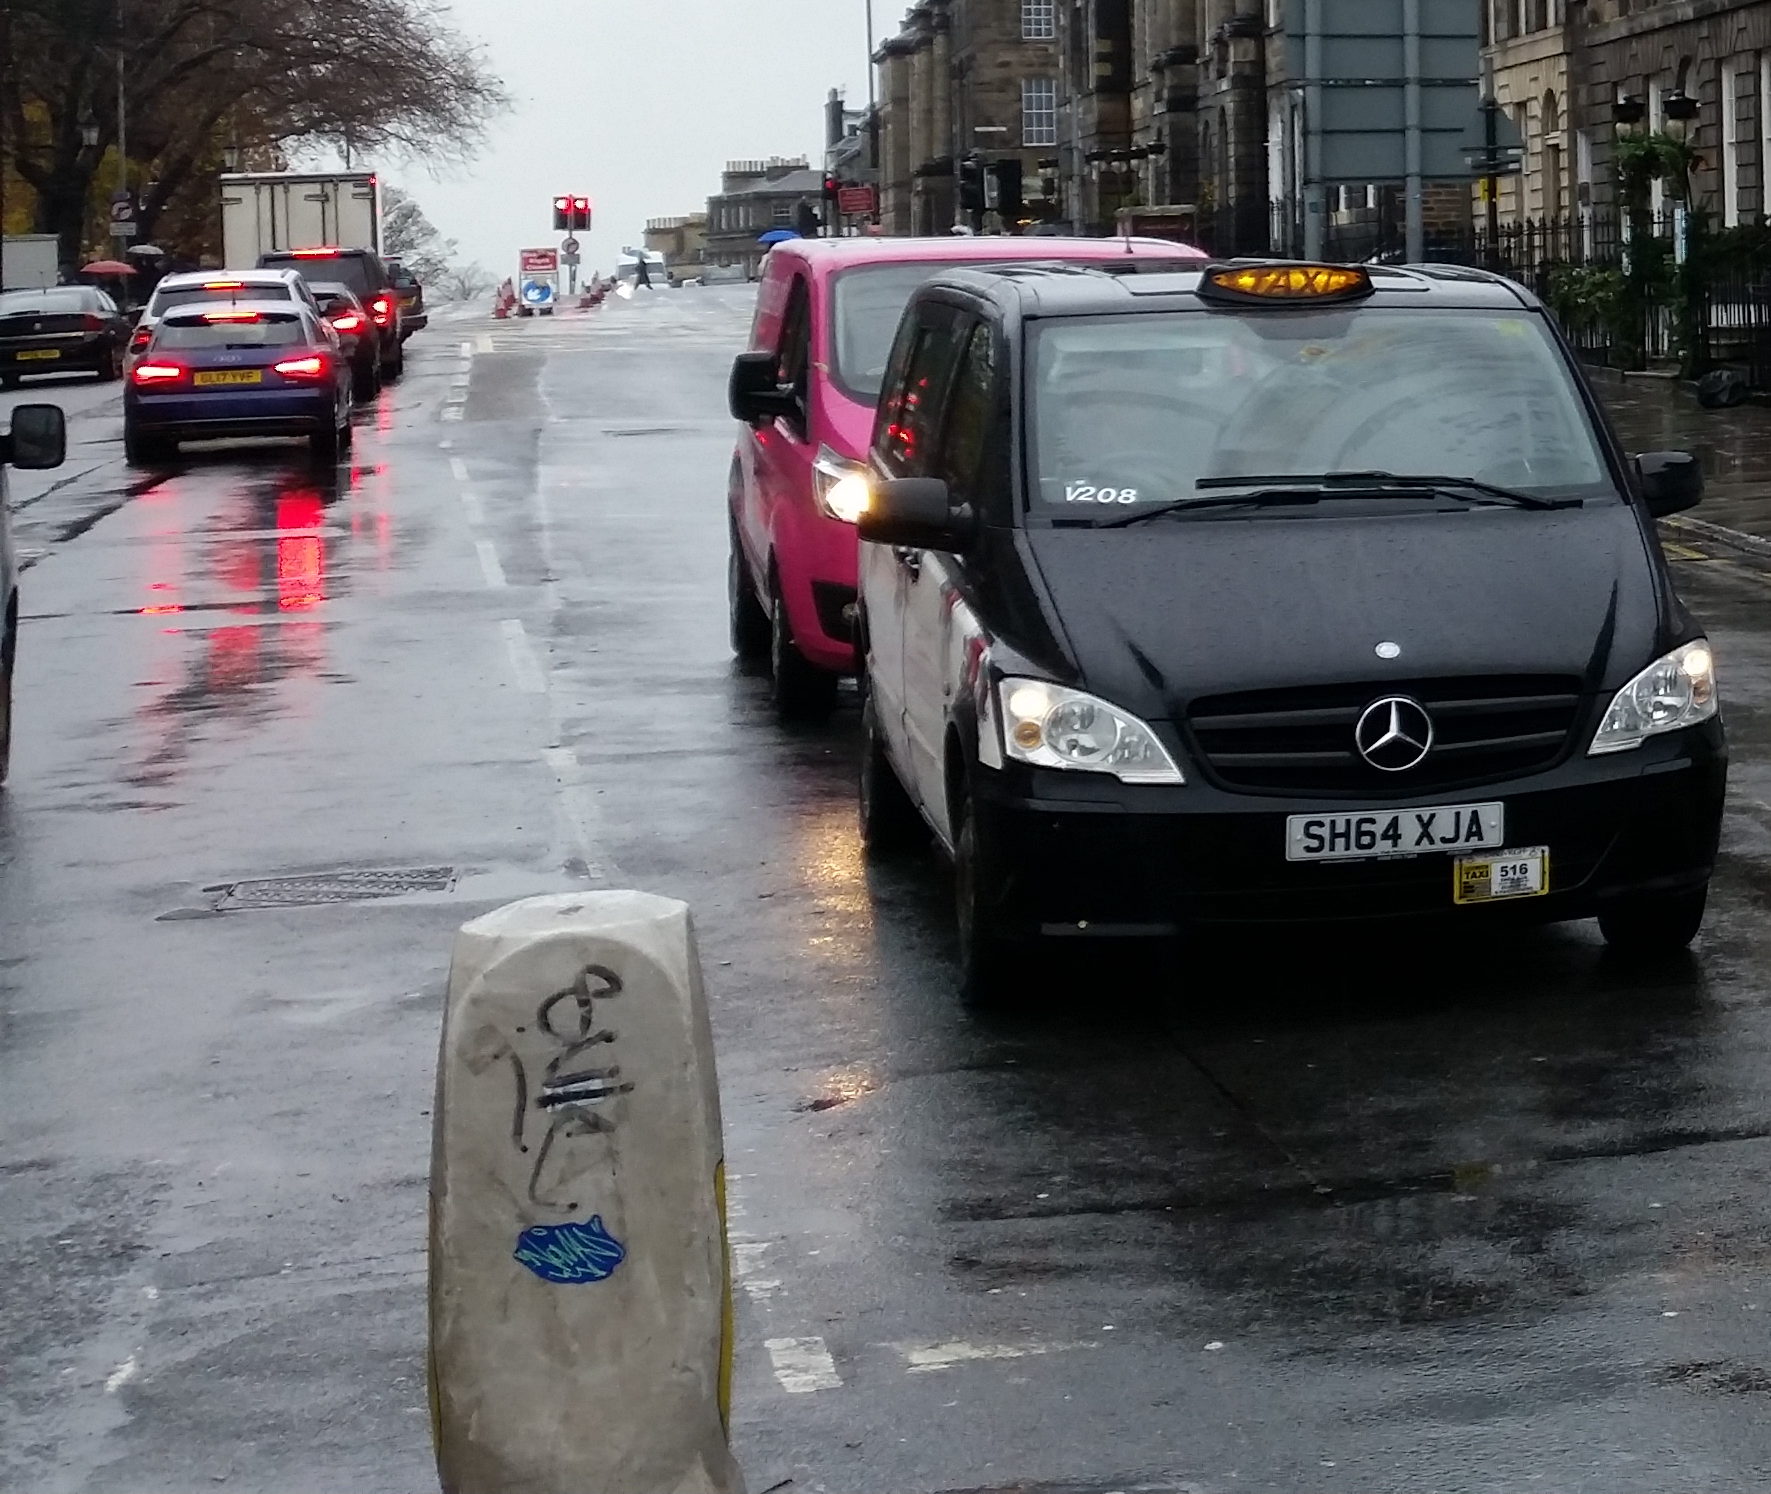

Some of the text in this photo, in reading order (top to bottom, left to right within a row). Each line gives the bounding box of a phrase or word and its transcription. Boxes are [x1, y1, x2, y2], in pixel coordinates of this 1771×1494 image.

[1302, 808, 1485, 854] SH64 XJA
[1464, 869, 1490, 880] TAXI
[1500, 863, 1529, 878] 516
